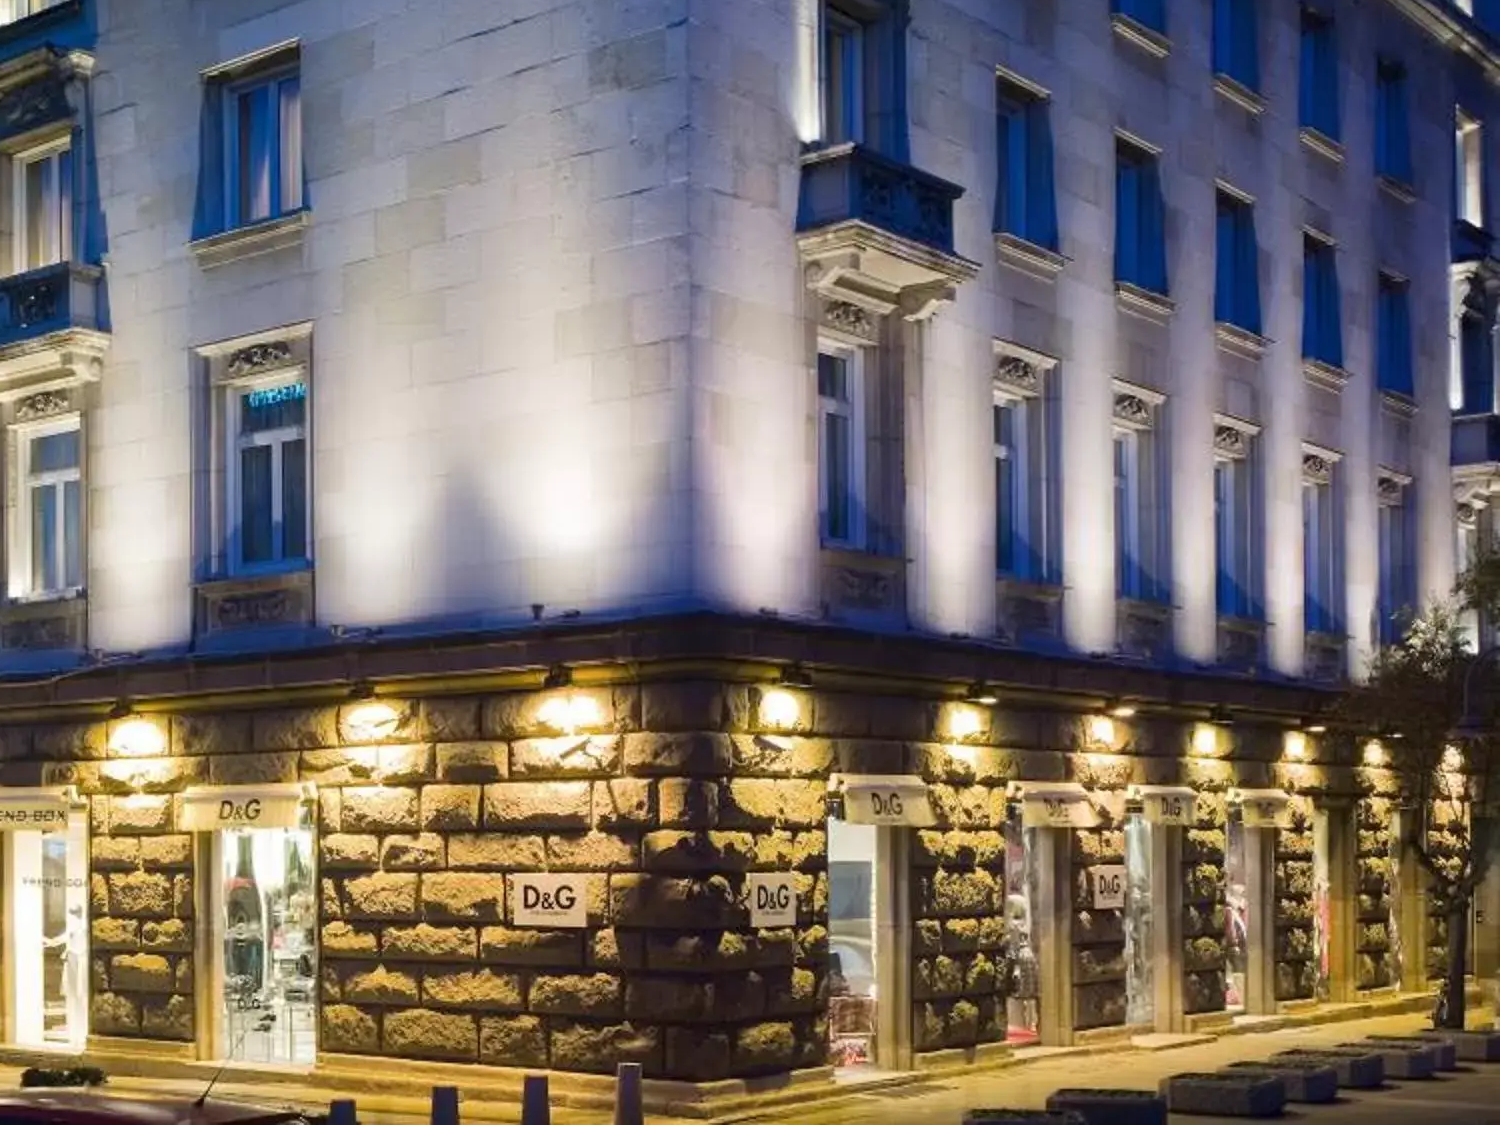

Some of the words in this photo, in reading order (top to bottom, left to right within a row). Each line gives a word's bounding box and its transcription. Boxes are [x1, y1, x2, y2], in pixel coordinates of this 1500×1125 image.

[218, 798, 261, 820] D&G
[871, 792, 903, 816] D&G
[33, 810, 65, 822] BOX
[1099, 874, 1121, 894] D&G
[522, 884, 577, 910] D&G
[757, 884, 790, 910] D&G
